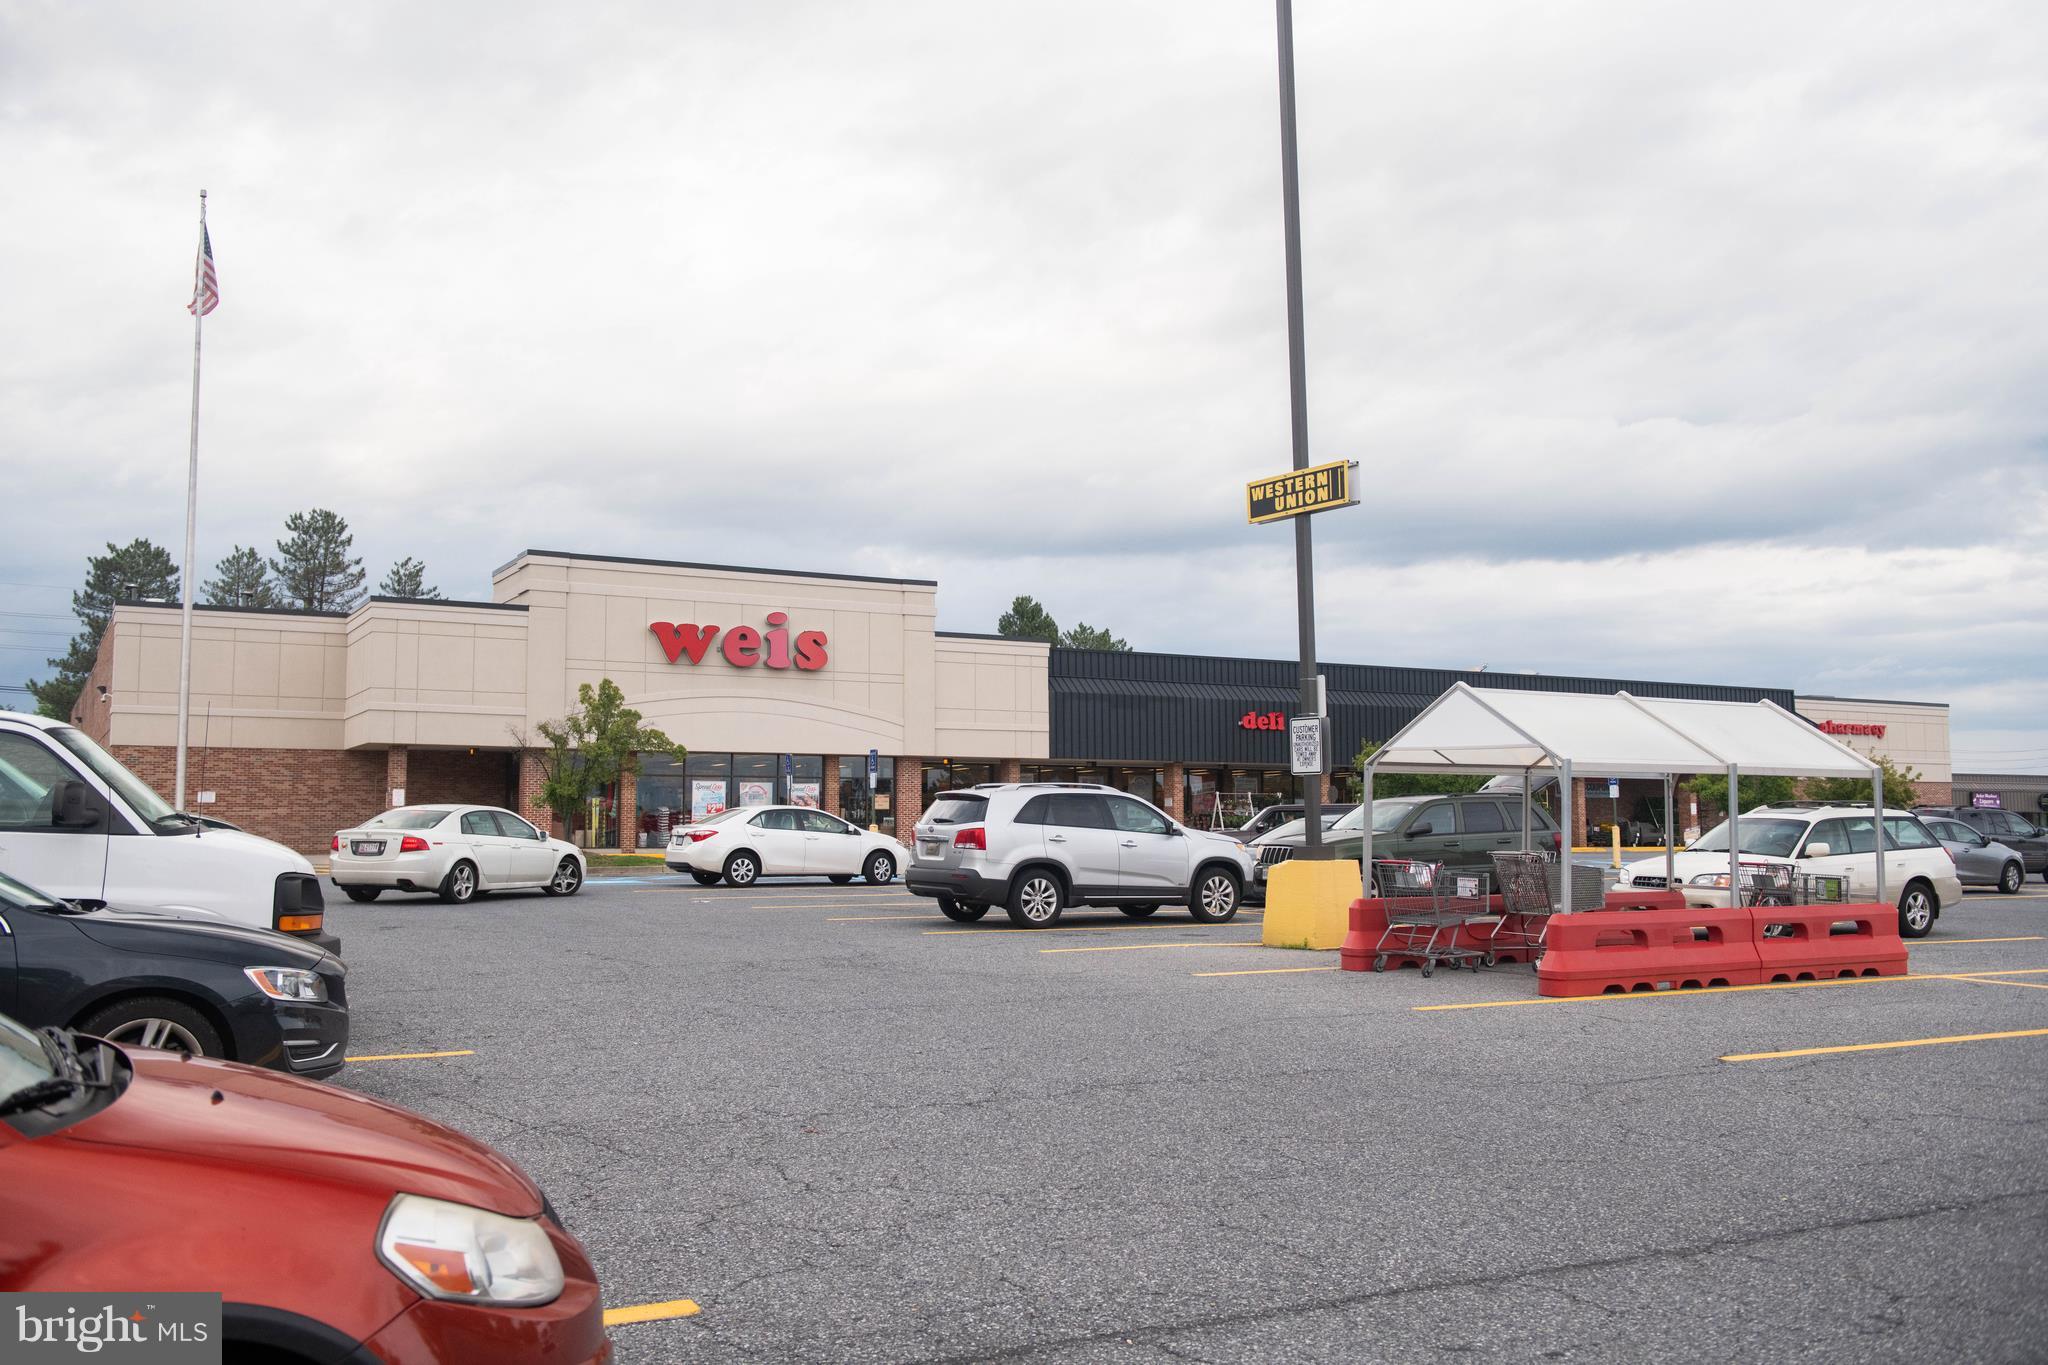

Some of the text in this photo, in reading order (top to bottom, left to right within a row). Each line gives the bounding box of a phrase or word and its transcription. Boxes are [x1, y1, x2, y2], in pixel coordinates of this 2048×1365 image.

[1251, 470, 1328, 501] WESTERN
[1274, 486, 1329, 511] UNION
[648, 611, 829, 671] weis
[1242, 711, 1285, 730] deli
[1293, 725, 1318, 734] CUSTOMER
[1296, 733, 1316, 741] PARKING
